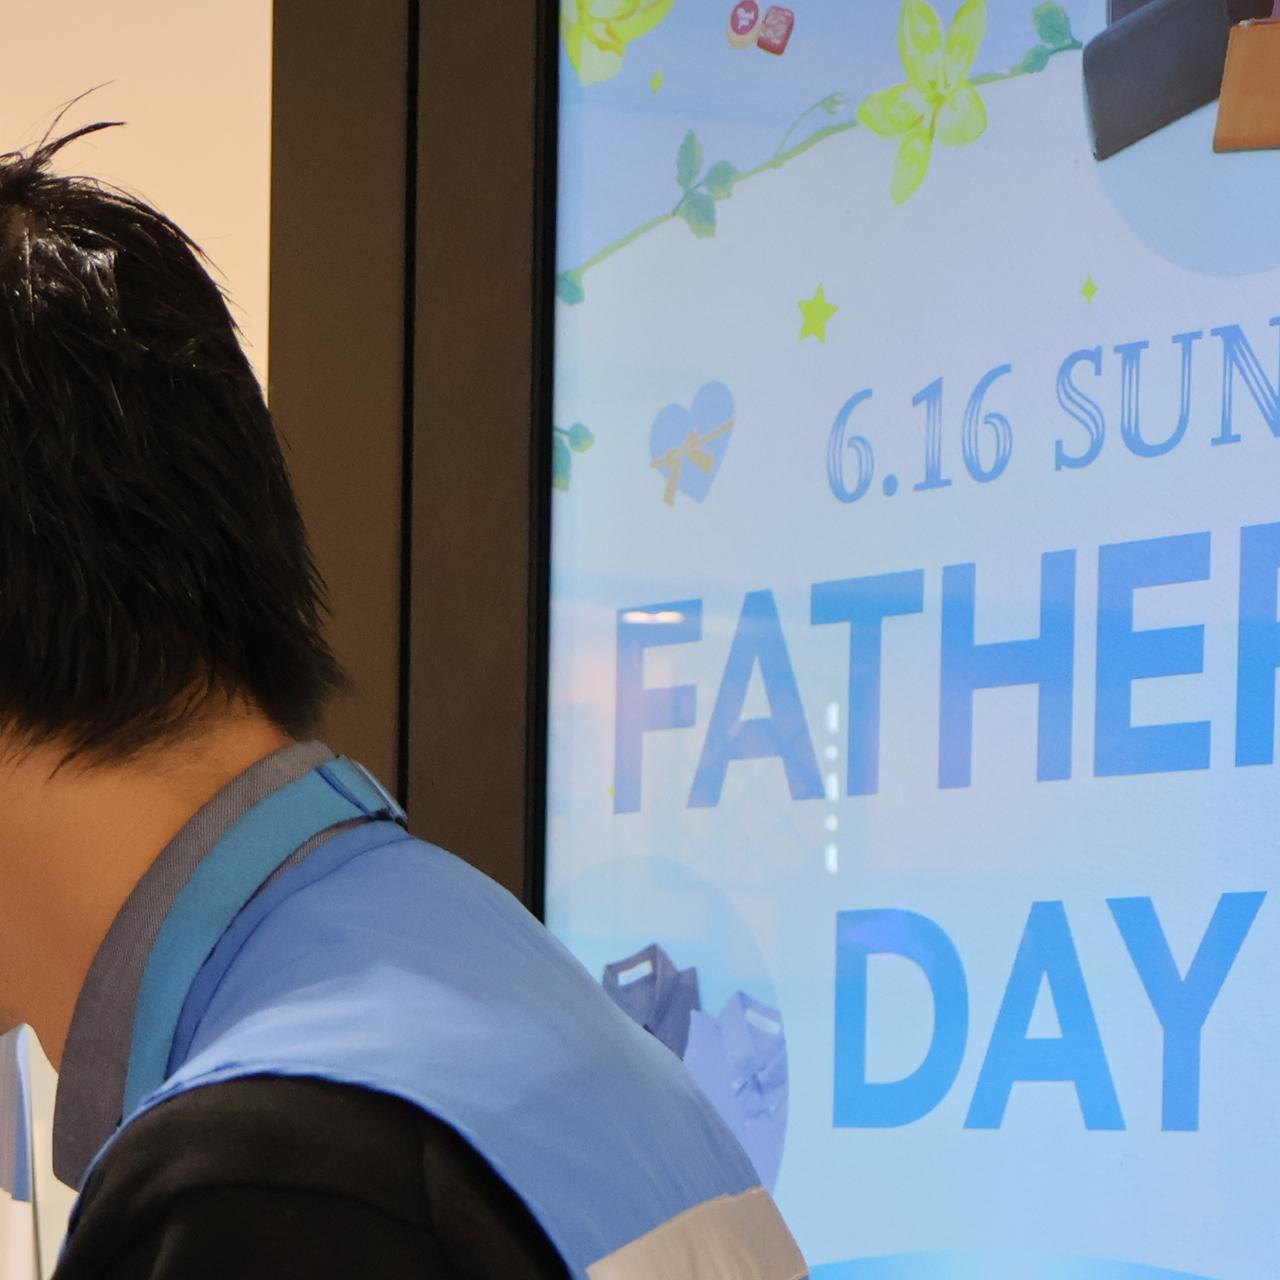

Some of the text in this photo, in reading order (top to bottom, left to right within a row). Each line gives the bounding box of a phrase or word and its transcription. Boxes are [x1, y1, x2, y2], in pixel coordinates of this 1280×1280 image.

[827, 316, 1280, 504] 6.16 SUN
[833, 890, 1268, 1132] DAY
